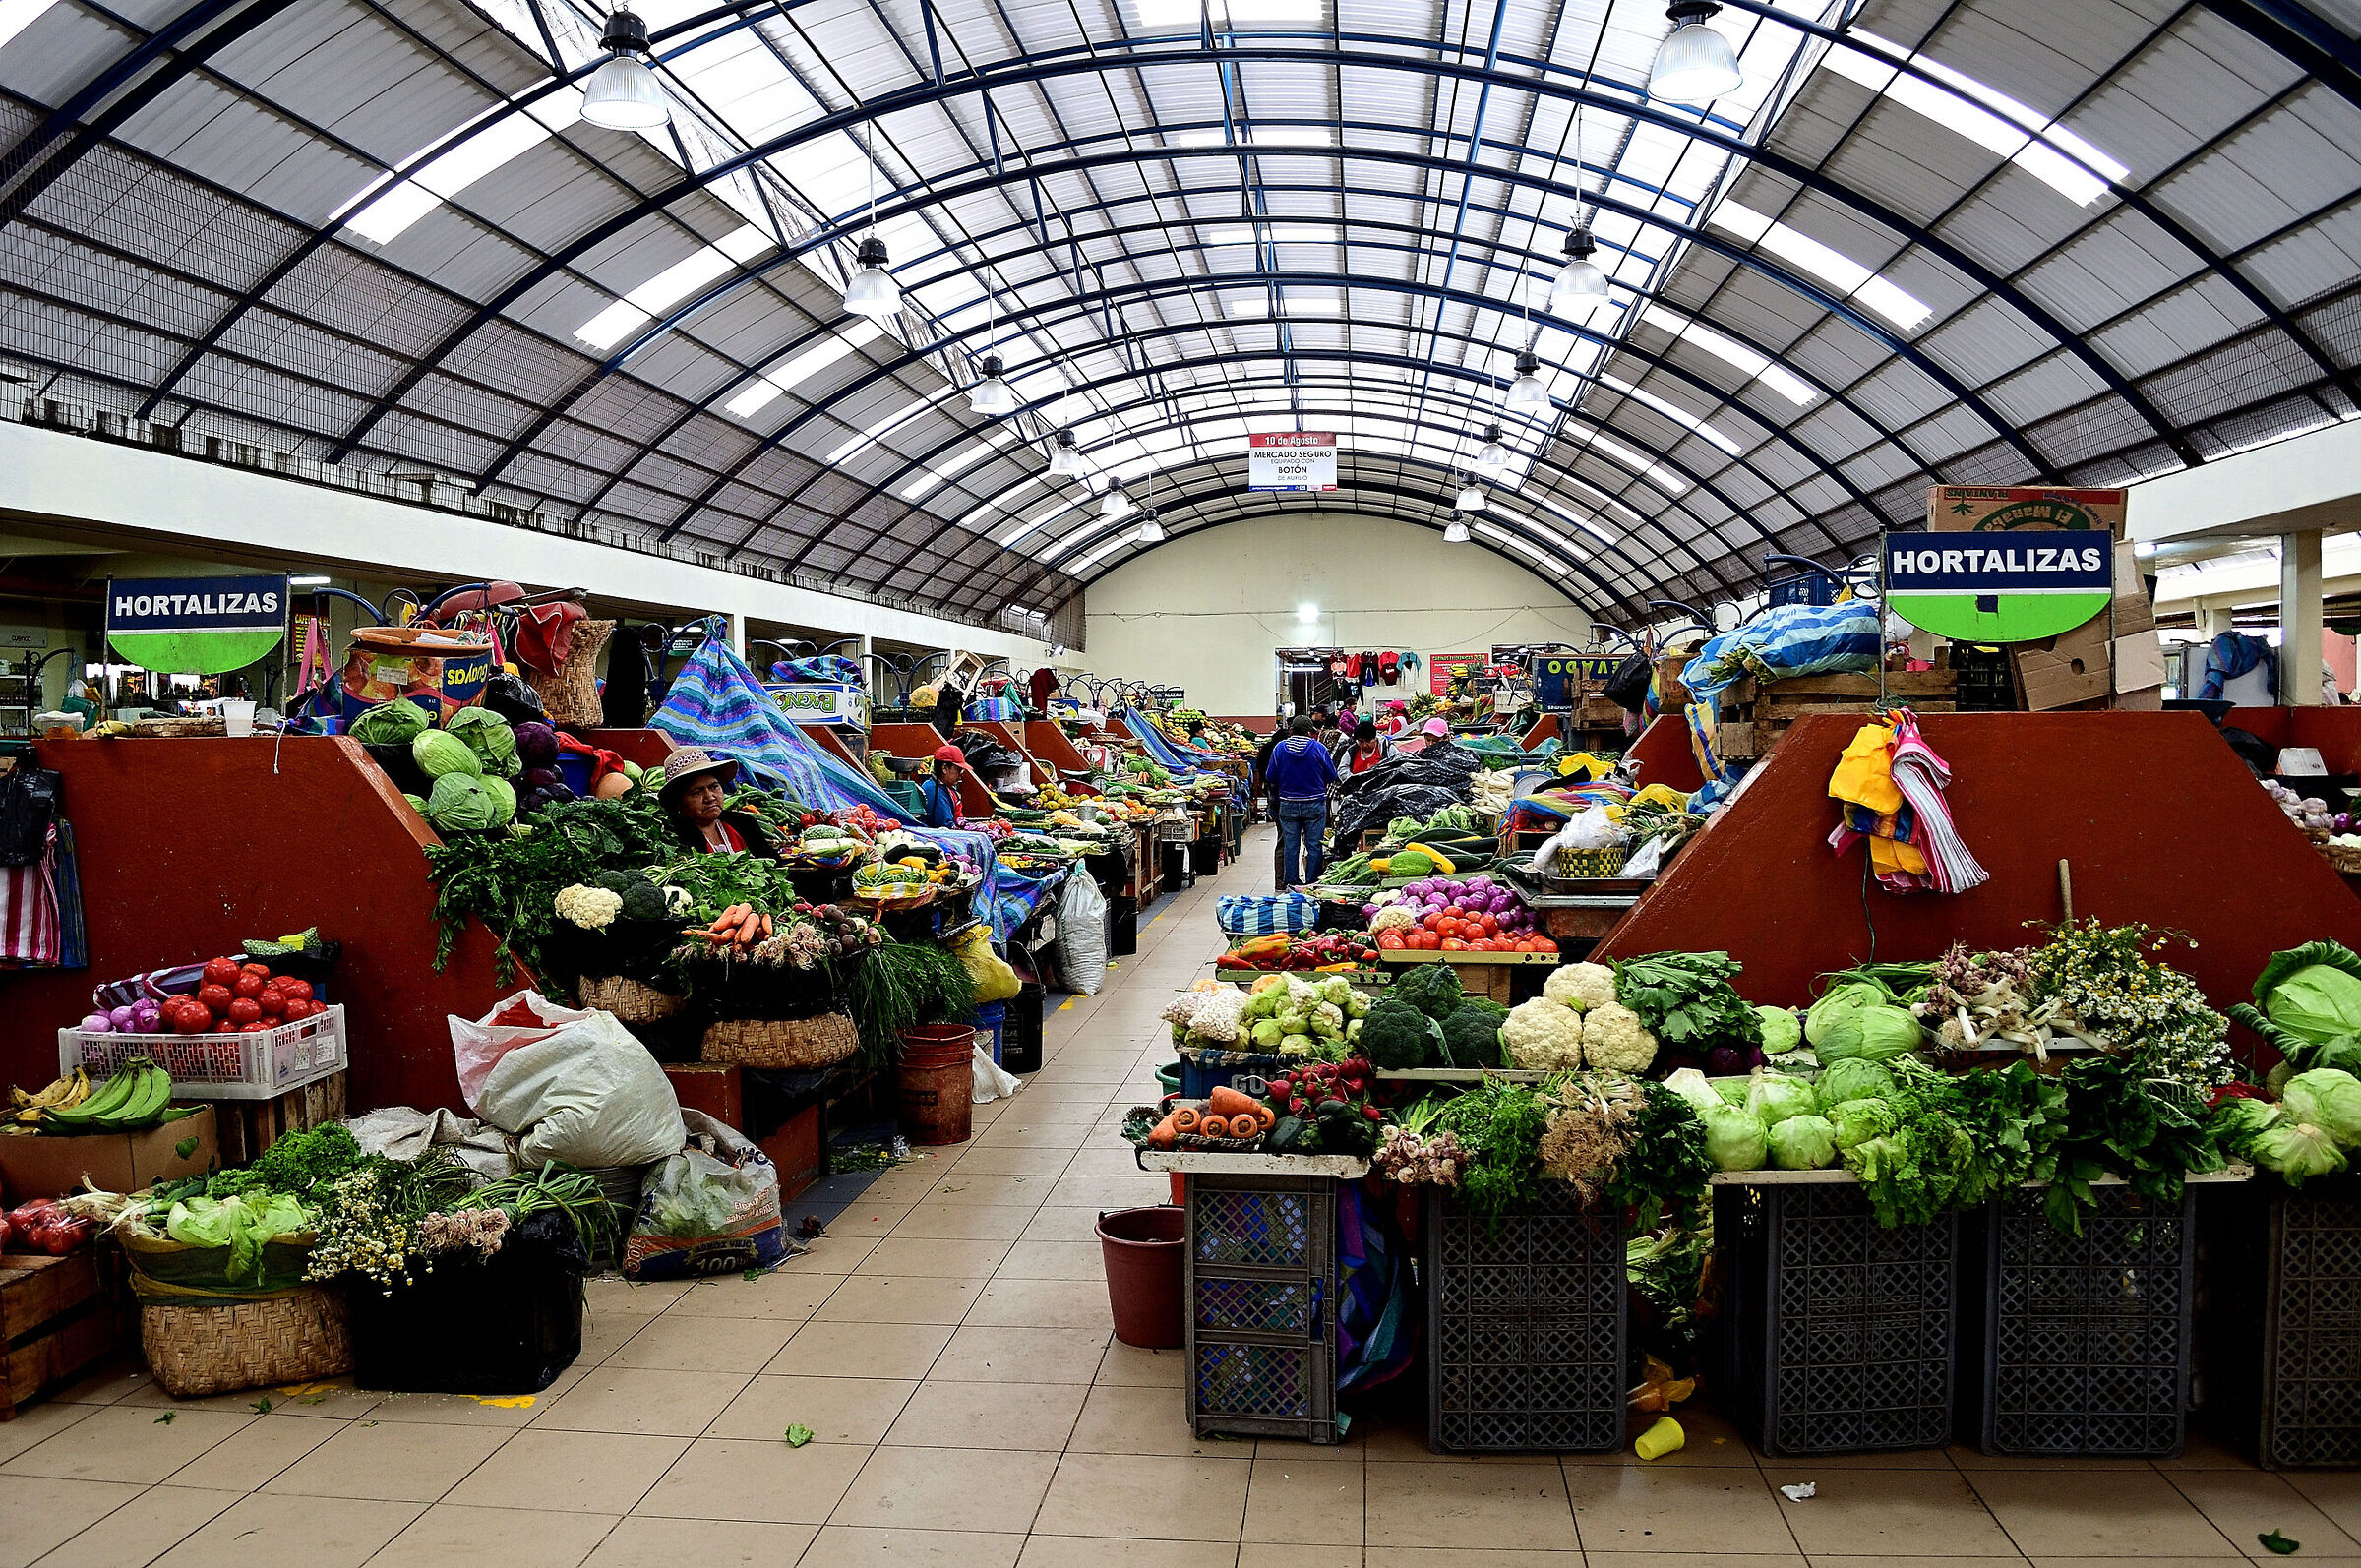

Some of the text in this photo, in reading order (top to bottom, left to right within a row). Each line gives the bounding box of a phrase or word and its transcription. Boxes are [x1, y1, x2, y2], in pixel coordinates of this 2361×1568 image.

[1265, 436, 1318, 447] 10 de Agosto
[1278, 464, 1307, 474] BOTÓN
[1893, 547, 2102, 574] HORTALIZAS
[115, 592, 278, 617] HORTALIZAS
[447, 663, 489, 685] Guayas
